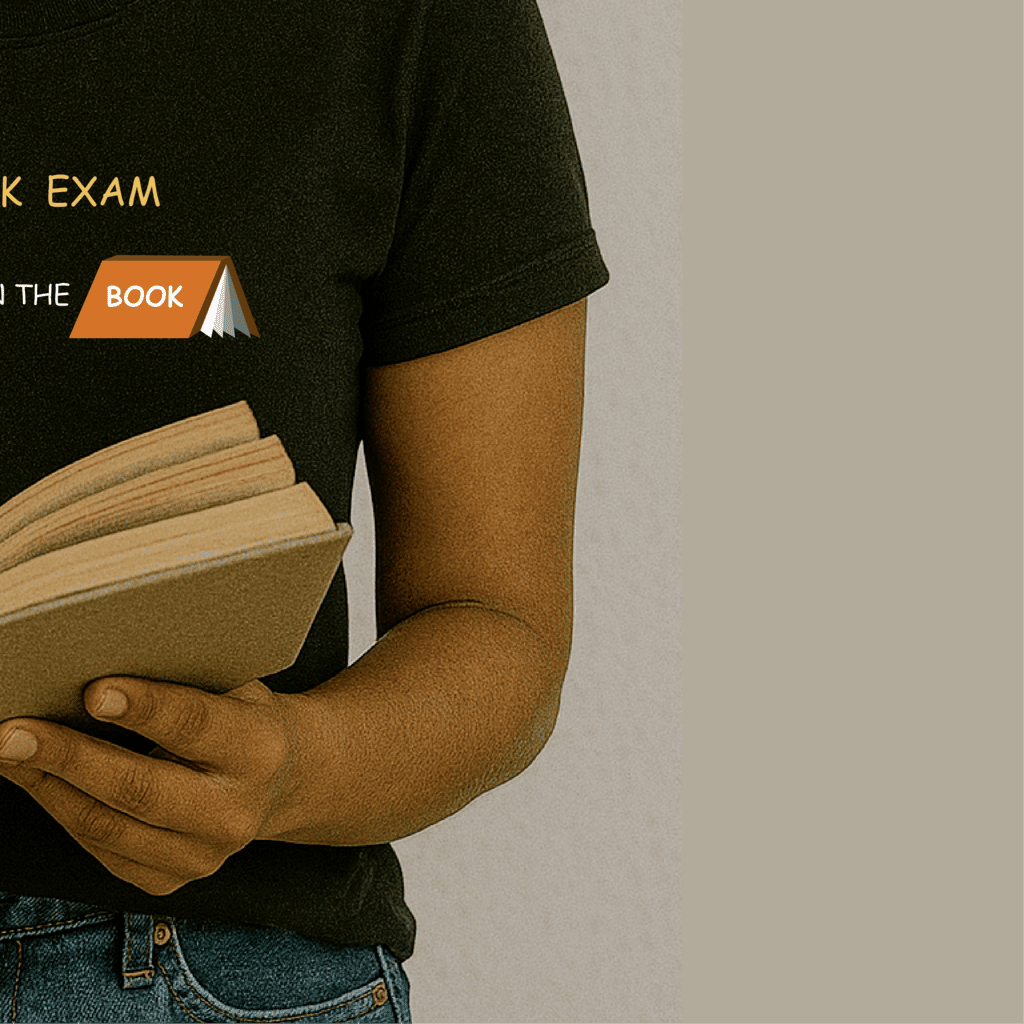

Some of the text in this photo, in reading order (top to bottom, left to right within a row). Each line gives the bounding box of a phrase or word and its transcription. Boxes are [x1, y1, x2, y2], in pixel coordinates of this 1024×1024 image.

[47, 173, 161, 208] EXAM
[14, 282, 71, 307] THE
[106, 284, 184, 309] BOOK
